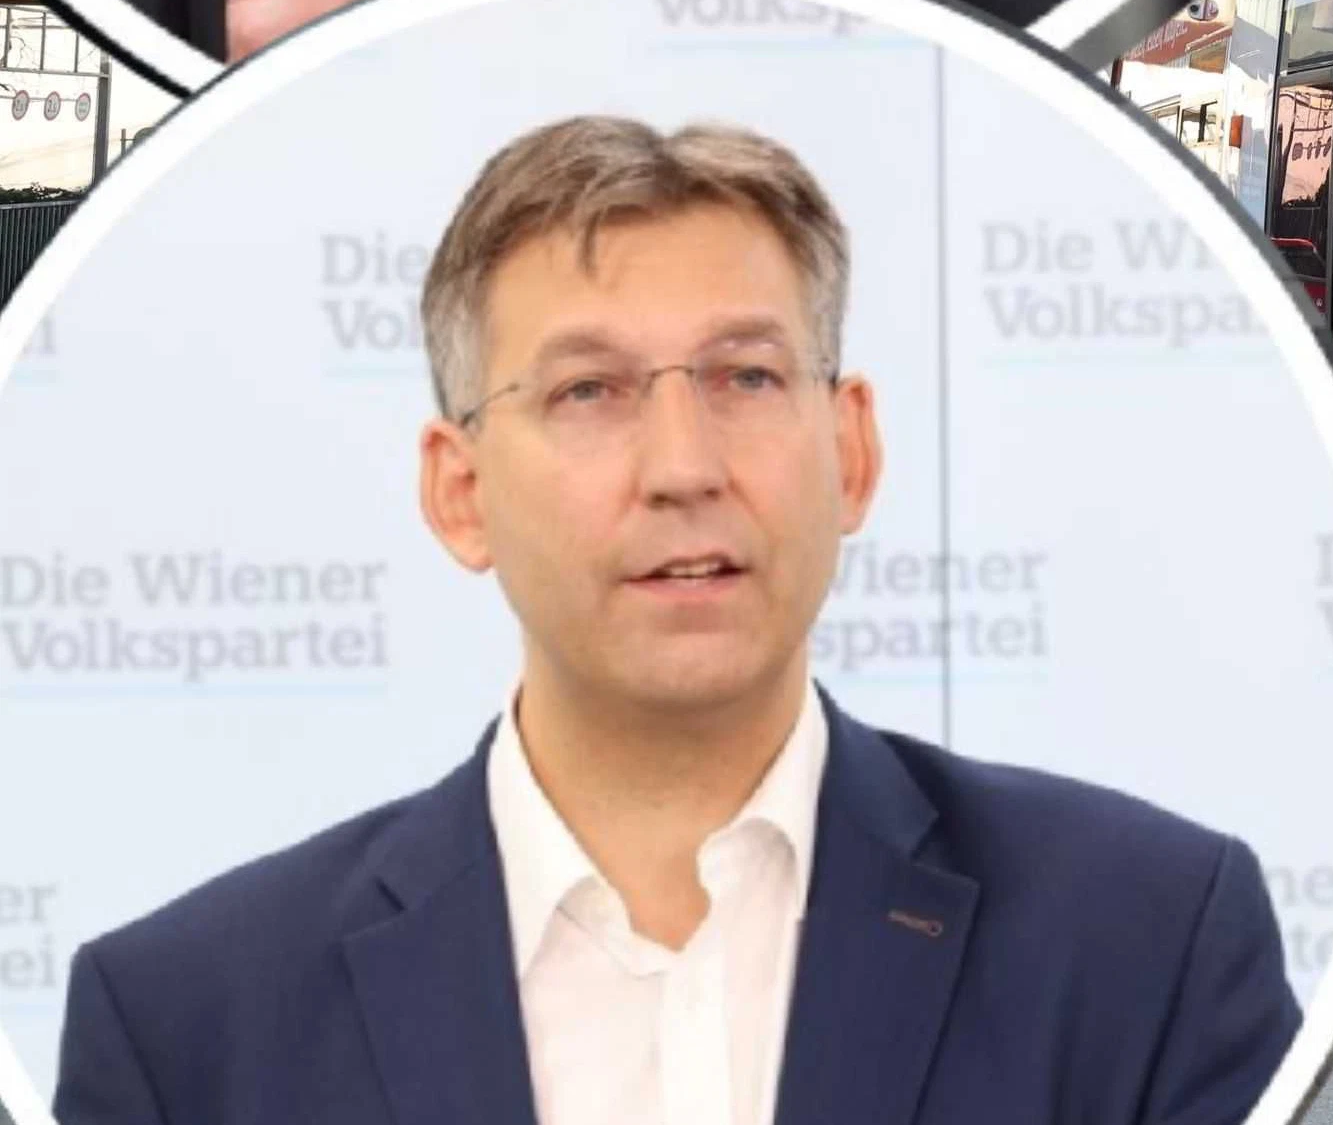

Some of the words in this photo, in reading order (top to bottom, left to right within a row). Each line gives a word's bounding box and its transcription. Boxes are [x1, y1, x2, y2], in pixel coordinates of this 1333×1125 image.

[980, 221, 1095, 277] Die
[982, 282, 1270, 348] Volkspa
[0, 554, 110, 609] Die
[129, 552, 389, 608] Wiener
[3, 618, 390, 681] Volkspartei
